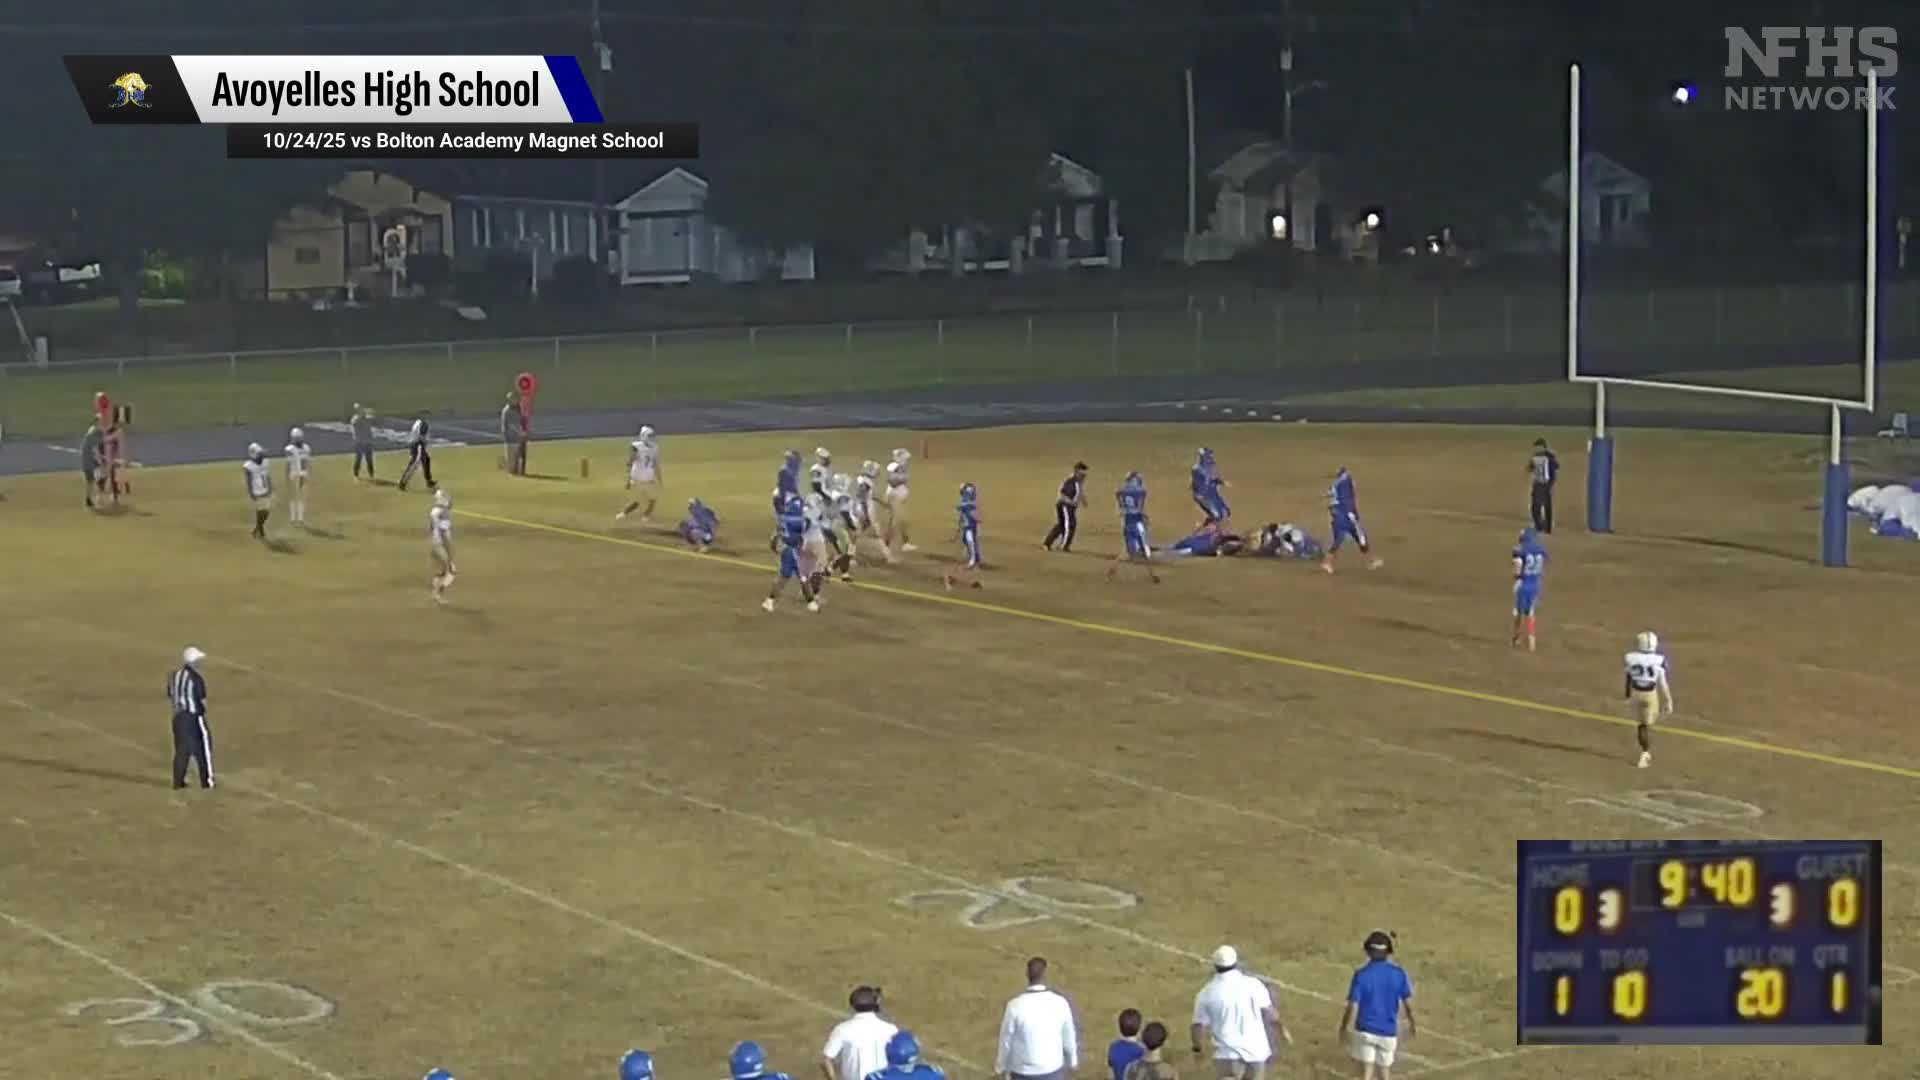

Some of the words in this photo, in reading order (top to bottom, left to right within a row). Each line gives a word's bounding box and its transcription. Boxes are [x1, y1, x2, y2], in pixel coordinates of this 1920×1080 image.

[1658, 858, 1754, 908] 9:40
[1770, 884, 1793, 924] 3
[1828, 879, 1857, 926] 0
[1555, 887, 1582, 933] 0
[1598, 889, 1621, 929] 3
[65, 979, 336, 1048] 30
[1737, 969, 1784, 1017] 20
